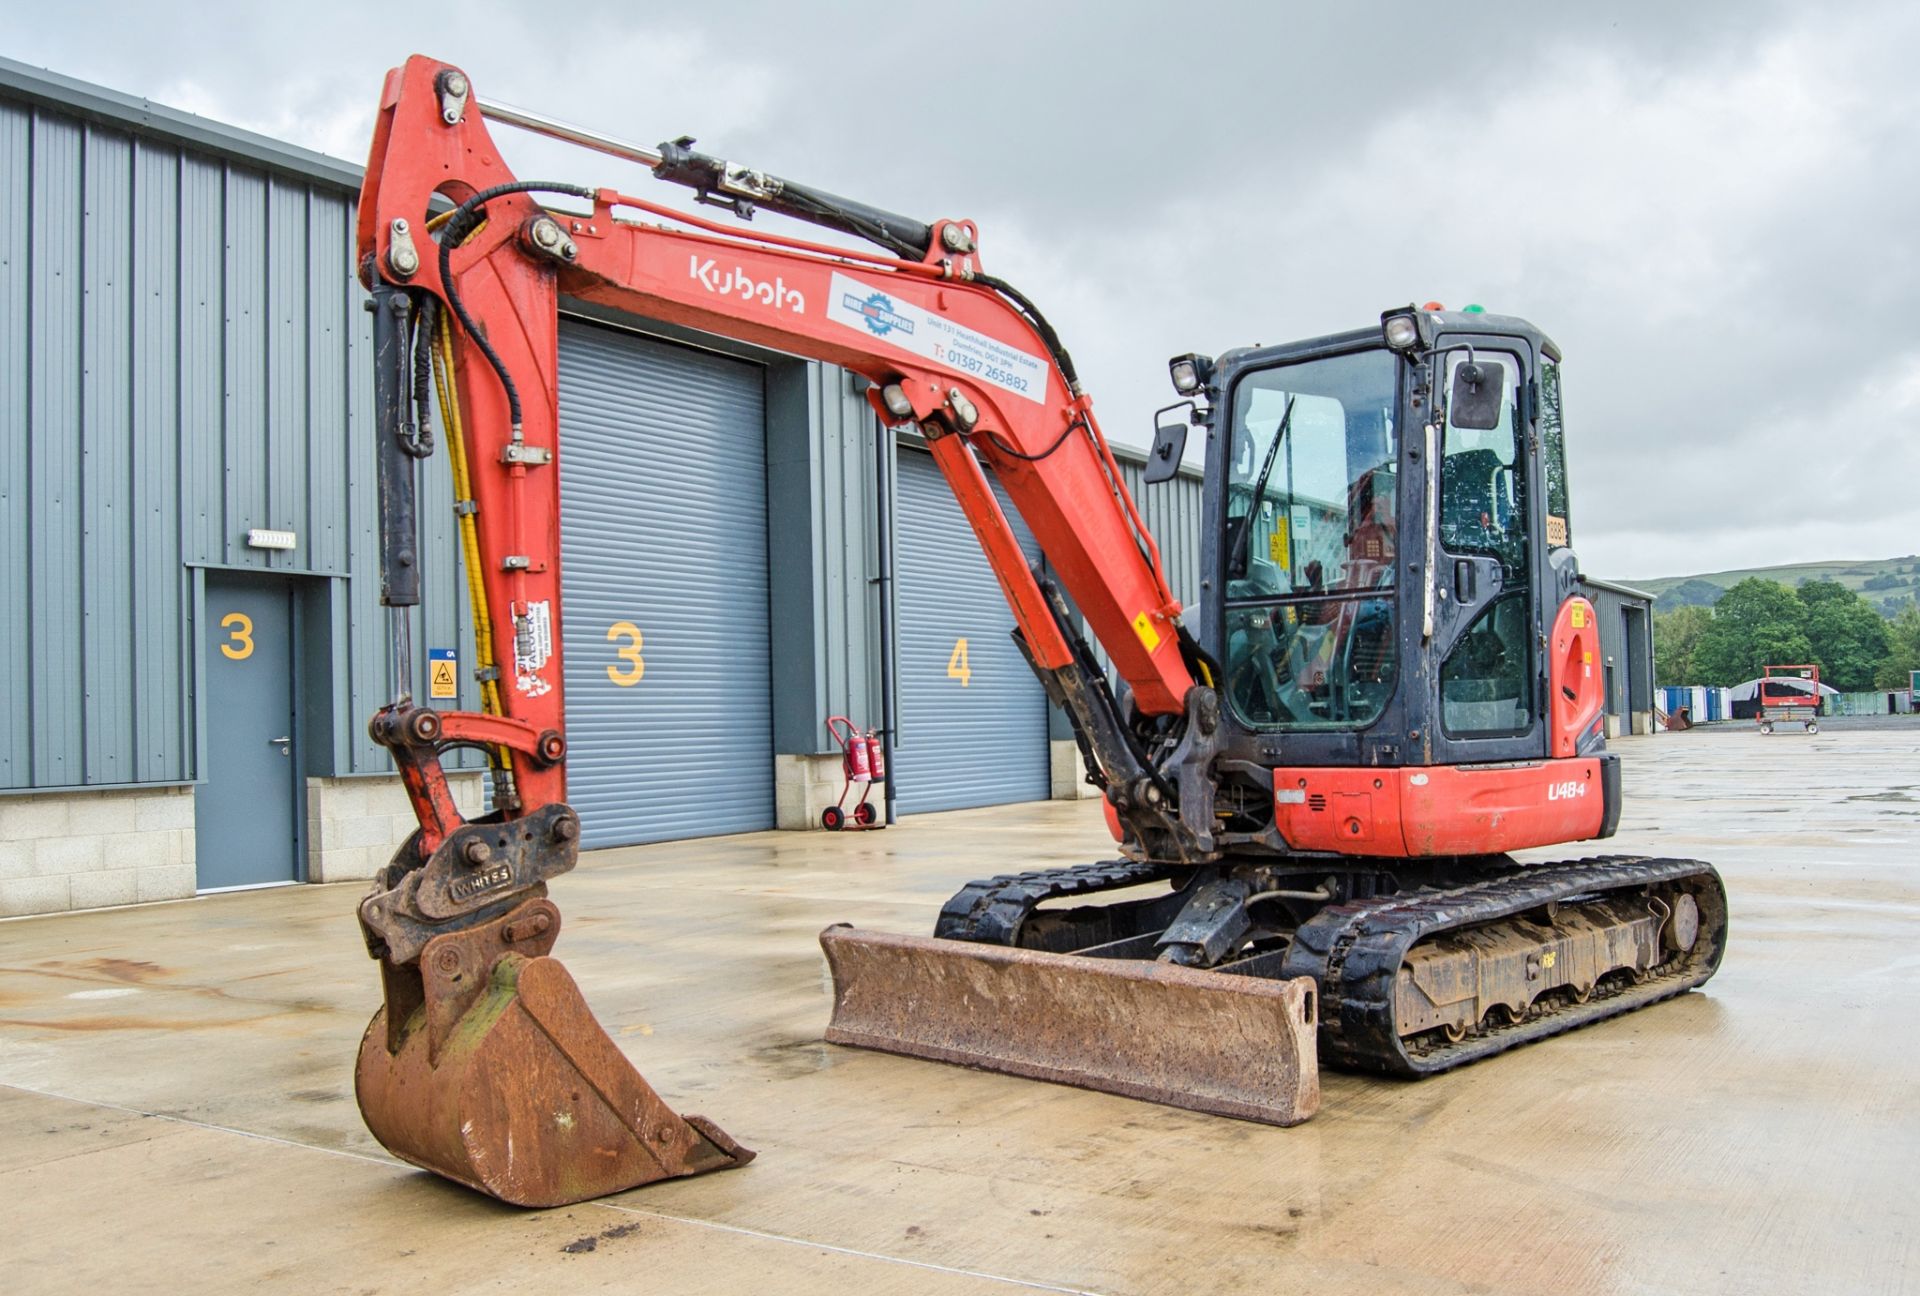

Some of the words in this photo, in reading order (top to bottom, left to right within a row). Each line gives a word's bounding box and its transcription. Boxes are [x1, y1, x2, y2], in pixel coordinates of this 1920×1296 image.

[690, 255, 805, 314] Kubota
[927, 317, 943, 329] Unit
[956, 327, 988, 349] Heathhall
[988, 342, 1019, 360] Industrial
[1019, 354, 1038, 369] Estate
[934, 343, 945, 358] T:
[948, 349, 984, 373] 01387
[984, 364, 1028, 392] 265882
[220, 612, 255, 660] 3
[606, 621, 645, 687] 3
[946, 638, 972, 687] 4
[454, 868, 509, 896] WHITES
